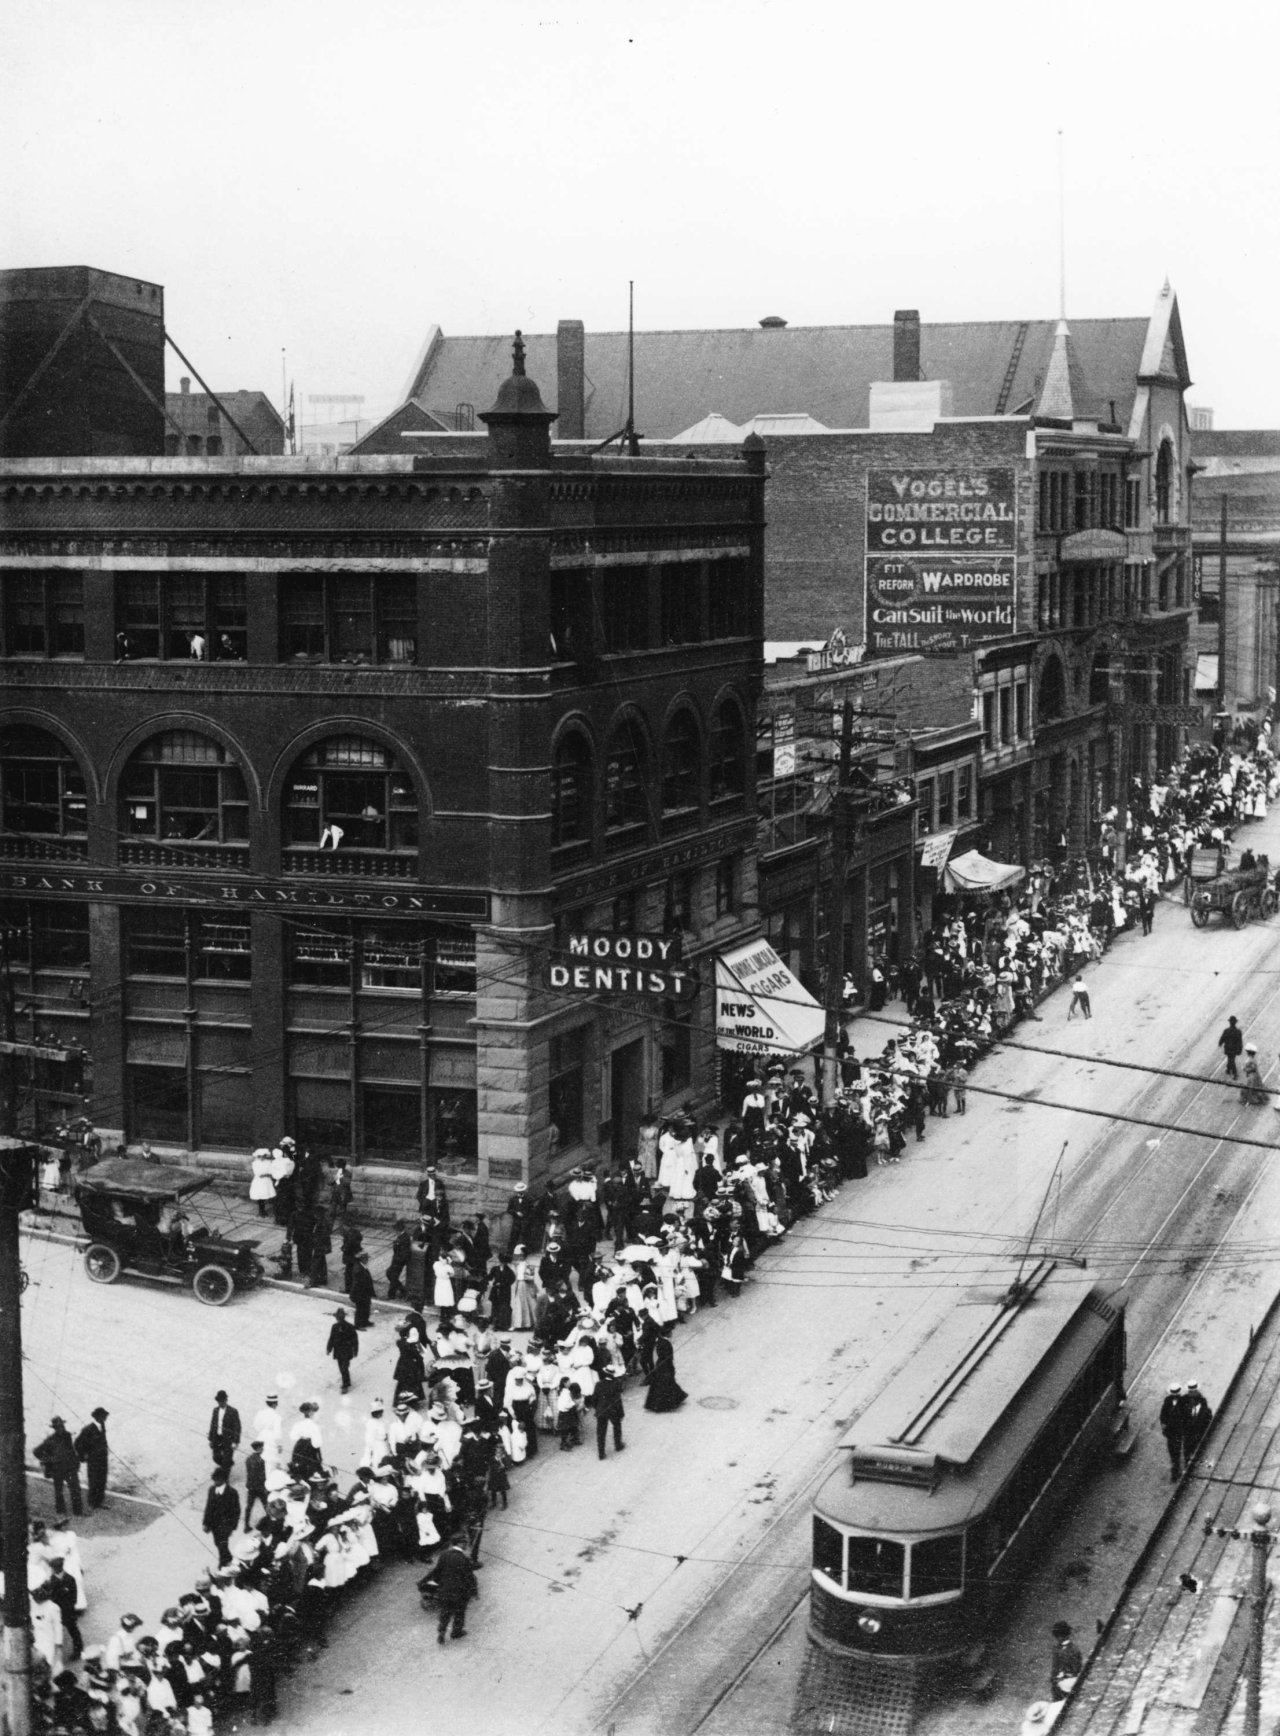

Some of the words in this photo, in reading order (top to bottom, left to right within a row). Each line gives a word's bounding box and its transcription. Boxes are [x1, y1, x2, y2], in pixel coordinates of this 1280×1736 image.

[869, 502, 1014, 522] COMMERCIAL
[884, 564, 905, 574] FIT
[1194, 557, 1202, 599] STUDIO
[878, 579, 914, 591] REFORM
[922, 571, 1011, 593] WARDROBE
[872, 608, 908, 624] Can
[909, 604, 944, 624] Suit
[960, 604, 1013, 624] World
[891, 631, 921, 649] TALL
[12, 876, 104, 891] BANK
[140, 882, 182, 896] OF
[569, 935, 672, 960] MOODY
[551, 966, 687, 993] DENTIST
[750, 970, 791, 996] CIGARS
[720, 1002, 755, 1018] NEWS
[717, 1026, 725, 1035] OF
[724, 1027, 735, 1036] THE
[736, 1042, 770, 1052] CIGARS
